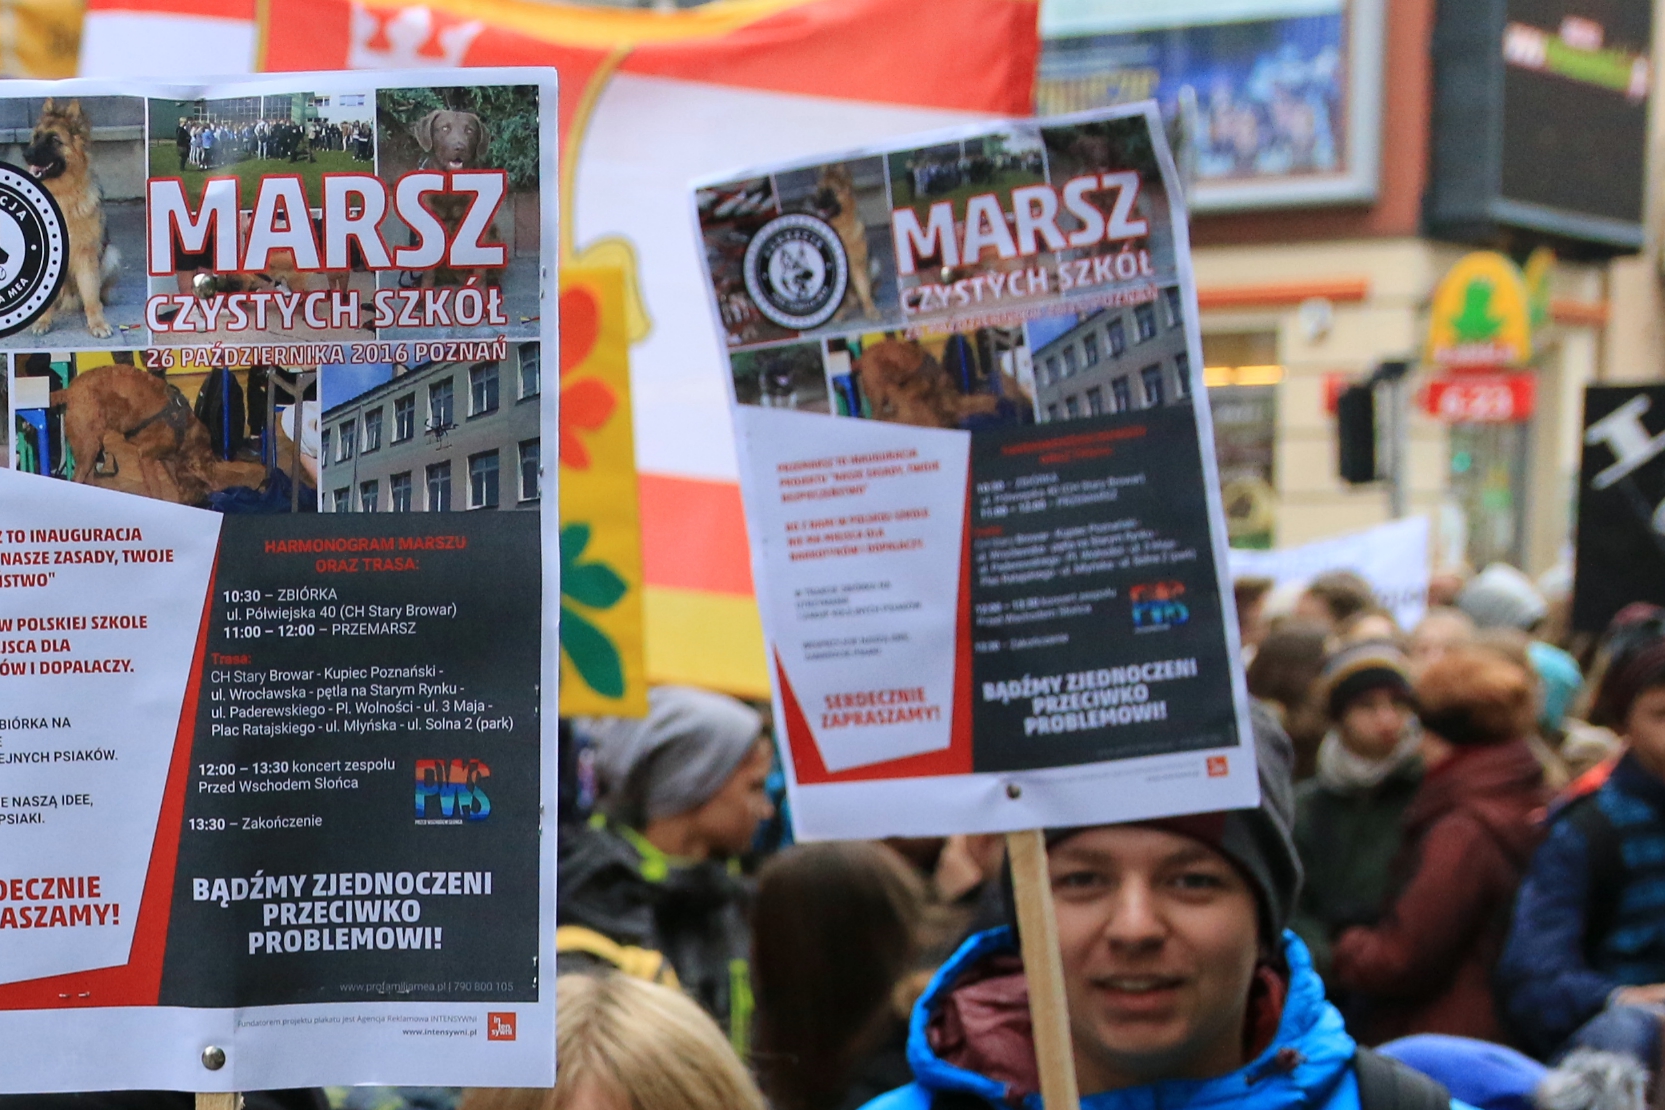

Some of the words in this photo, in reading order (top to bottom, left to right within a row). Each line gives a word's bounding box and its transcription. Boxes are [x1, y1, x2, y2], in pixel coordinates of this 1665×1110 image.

[147, 169, 507, 276] MARSZ
[892, 169, 1149, 276] MARSZ
[7, 277, 28, 299] MEA
[899, 266, 1049, 315] CZYSTYCH
[1057, 242, 1155, 289] SZKÓŁ
[145, 289, 361, 332] CZYSTYCH
[374, 275, 508, 328] SZKÓŁ
[147, 347, 174, 368] 26
[181, 342, 345, 366] PAŹDZIERNIKA
[352, 342, 408, 364] 2016
[414, 335, 507, 362] POZNAŃ
[6, 529, 26, 544] TO
[30, 528, 142, 543] INAUGURACJA
[264, 537, 394, 553] HARMONOGRAM
[398, 536, 467, 550] MARSZU
[54, 550, 119, 566] ZASADY,
[122, 549, 174, 563] TWOJE
[315, 558, 359, 574] ORAZ
[362, 557, 420, 572] TRASA:
[223, 590, 261, 603] 10:30
[277, 586, 338, 601] ZBIÓRKA
[226, 608, 242, 621] ul.
[246, 605, 316, 621] Półwiejska
[320, 606, 336, 618] 40
[340, 605, 364, 621] (CH
[368, 604, 402, 620] Stary
[406, 602, 457, 619] Browar)
[17, 616, 87, 632] POLSKIEJ
[91, 615, 148, 630] SZKOLE
[223, 626, 261, 639] 11:00
[277, 624, 315, 637] 12:00
[332, 621, 416, 636] PRZEMARSZ
[41, 638, 71, 653] DLA
[30, 661, 36, 675] I
[39, 659, 135, 675] DOPALACZY.
[211, 653, 252, 665] Trasa:
[211, 671, 230, 683] CH
[233, 670, 266, 686] Stary
[269, 668, 314, 682] Browar
[324, 666, 367, 683] Kupiec
[371, 665, 436, 679] Poznański
[982, 673, 1063, 706] BĄDŹMY
[1066, 658, 1198, 692] ZJEDNOCZENI
[211, 689, 226, 701] ul.
[229, 686, 307, 701] Wrocławska
[316, 684, 348, 701] pętla
[351, 687, 367, 698] na
[370, 683, 415, 700] Starym
[419, 682, 457, 699] Rynku
[824, 687, 925, 710] SERDECZNIE
[1031, 683, 1149, 716] PRZECIWKO
[211, 706, 226, 720] ul.
[230, 704, 325, 721] Paderewskiego
[355, 700, 414, 715] Wolności
[424, 700, 439, 713] ul.
[442, 700, 451, 712] 3
[454, 699, 485, 715] Maja
[821, 706, 941, 730] ZAPRASZAMY!
[1024, 701, 1168, 736] PROBLEMOWI!
[52, 717, 71, 729] NA
[211, 724, 239, 737] Plac
[242, 722, 315, 738] Ratajskiego
[325, 720, 340, 733] ul.
[344, 718, 397, 735] Młyńska
[407, 718, 422, 731] ul.
[425, 717, 461, 731] Solna
[464, 717, 473, 730] 2
[476, 716, 514, 733] (park)
[54, 747, 118, 763] PSIAKÓW.
[198, 763, 236, 776] 12:00
[252, 761, 289, 774] 13:30
[292, 760, 341, 774] koncert
[344, 758, 396, 774] zespołu
[198, 780, 236, 794] Przed
[239, 778, 311, 793] Wschodem
[314, 776, 359, 790] Słońca
[415, 758, 491, 819] PWS
[12, 795, 58, 809] NASZĄ
[62, 794, 94, 807] IDEE,
[188, 817, 226, 831] 13:30
[242, 814, 323, 830] Zakończenie
[192, 870, 307, 908] BĄDŹMY
[312, 871, 492, 896] ZJEDNOCZENI
[263, 899, 421, 926] PRZECIWKO
[248, 926, 442, 955] PROBLEMOWI!
[454, 981, 472, 991] 790
[475, 981, 493, 991] 800
[496, 981, 514, 991] 105
[237, 1019, 280, 1028] Fundatorem
[282, 1017, 313, 1027] projektu
[313, 1015, 341, 1025] plakatu
[341, 1015, 355, 1024] jest
[356, 1015, 386, 1025] Agencja
[387, 1014, 429, 1023] Reklamowa
[430, 1014, 477, 1023] INTENSYWNI
[402, 1028, 477, 1038] www.intensywni.pl
